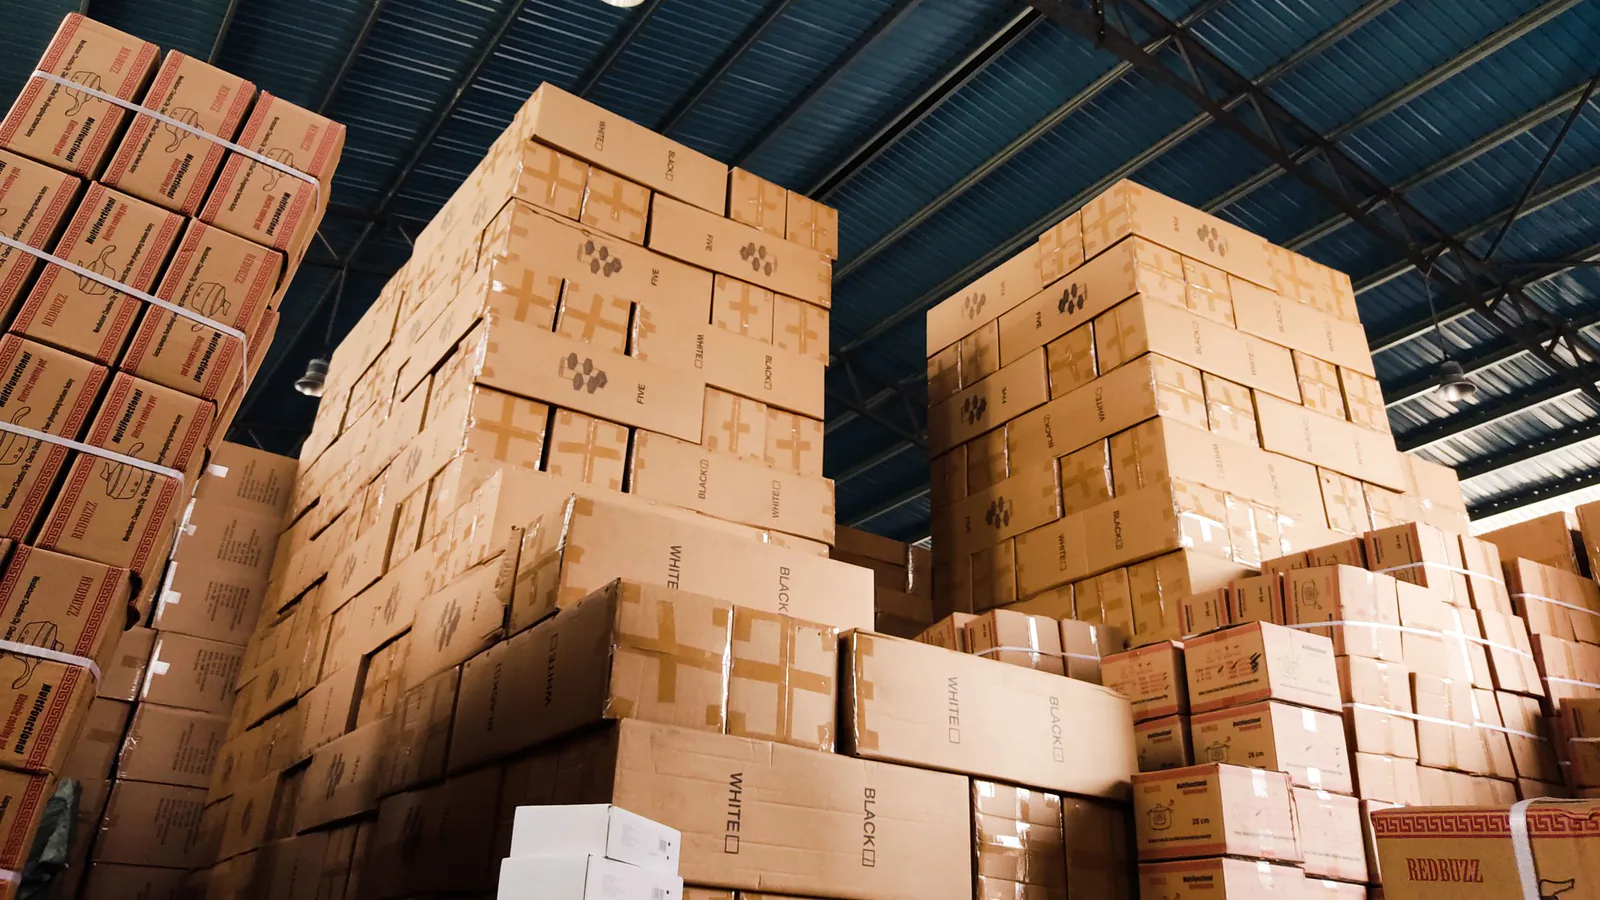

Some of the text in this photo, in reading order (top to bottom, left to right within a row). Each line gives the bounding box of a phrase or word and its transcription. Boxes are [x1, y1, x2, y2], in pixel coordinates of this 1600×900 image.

[109, 46, 132, 75] REDBUZZ
[210, 85, 231, 113] REDBUZZ
[65, 116, 96, 163] Multifunctional
[594, 121, 606, 147] WHITE
[52, 147, 62, 156] pot
[665, 150, 676, 175] BLACK
[166, 153, 194, 200] Multifunctional
[85, 196, 116, 244] Multifunctional
[119, 203, 128, 212] pot
[266, 192, 291, 236] Multifunctional
[705, 234, 714, 252] FIVE
[234, 253, 256, 284] REDBUZZ
[650, 268, 660, 286] FIVE
[41, 293, 68, 328] REDBUZZ
[695, 334, 704, 361] WHITE
[1194, 326, 1202, 355] BLACK
[180, 364, 191, 376] pot
[193, 332, 222, 383] Multifunctional
[764, 355, 772, 383] BLACK
[0, 351, 32, 408] Multifunctional
[16, 384, 34, 403] Electric
[37, 358, 48, 371] pot
[636, 384, 646, 404] FIVE
[112, 388, 143, 444] Multifunctional
[130, 420, 146, 439] Electric
[147, 395, 157, 408] pot
[1212, 444, 1223, 469] WHITE
[698, 470, 708, 500] BLACK
[772, 488, 780, 518] WHITE
[70, 500, 98, 540] REDBUZZ
[1113, 510, 1122, 541] BLACK
[1058, 534, 1066, 561] WHITE
[667, 546, 682, 590] WHITE
[66, 576, 94, 618] REDBUZZ
[778, 566, 790, 612] BLACK
[11, 693, 28, 716] Electric
[948, 677, 960, 726] WHITE
[0, 712, 18, 739] cooking
[14, 683, 52, 755] Multifunctional
[1049, 696, 1062, 748] BLACK
[726, 772, 743, 832] WHITE
[862, 787, 876, 851] BLACK
[1405, 858, 1484, 883] REDBUZZ
